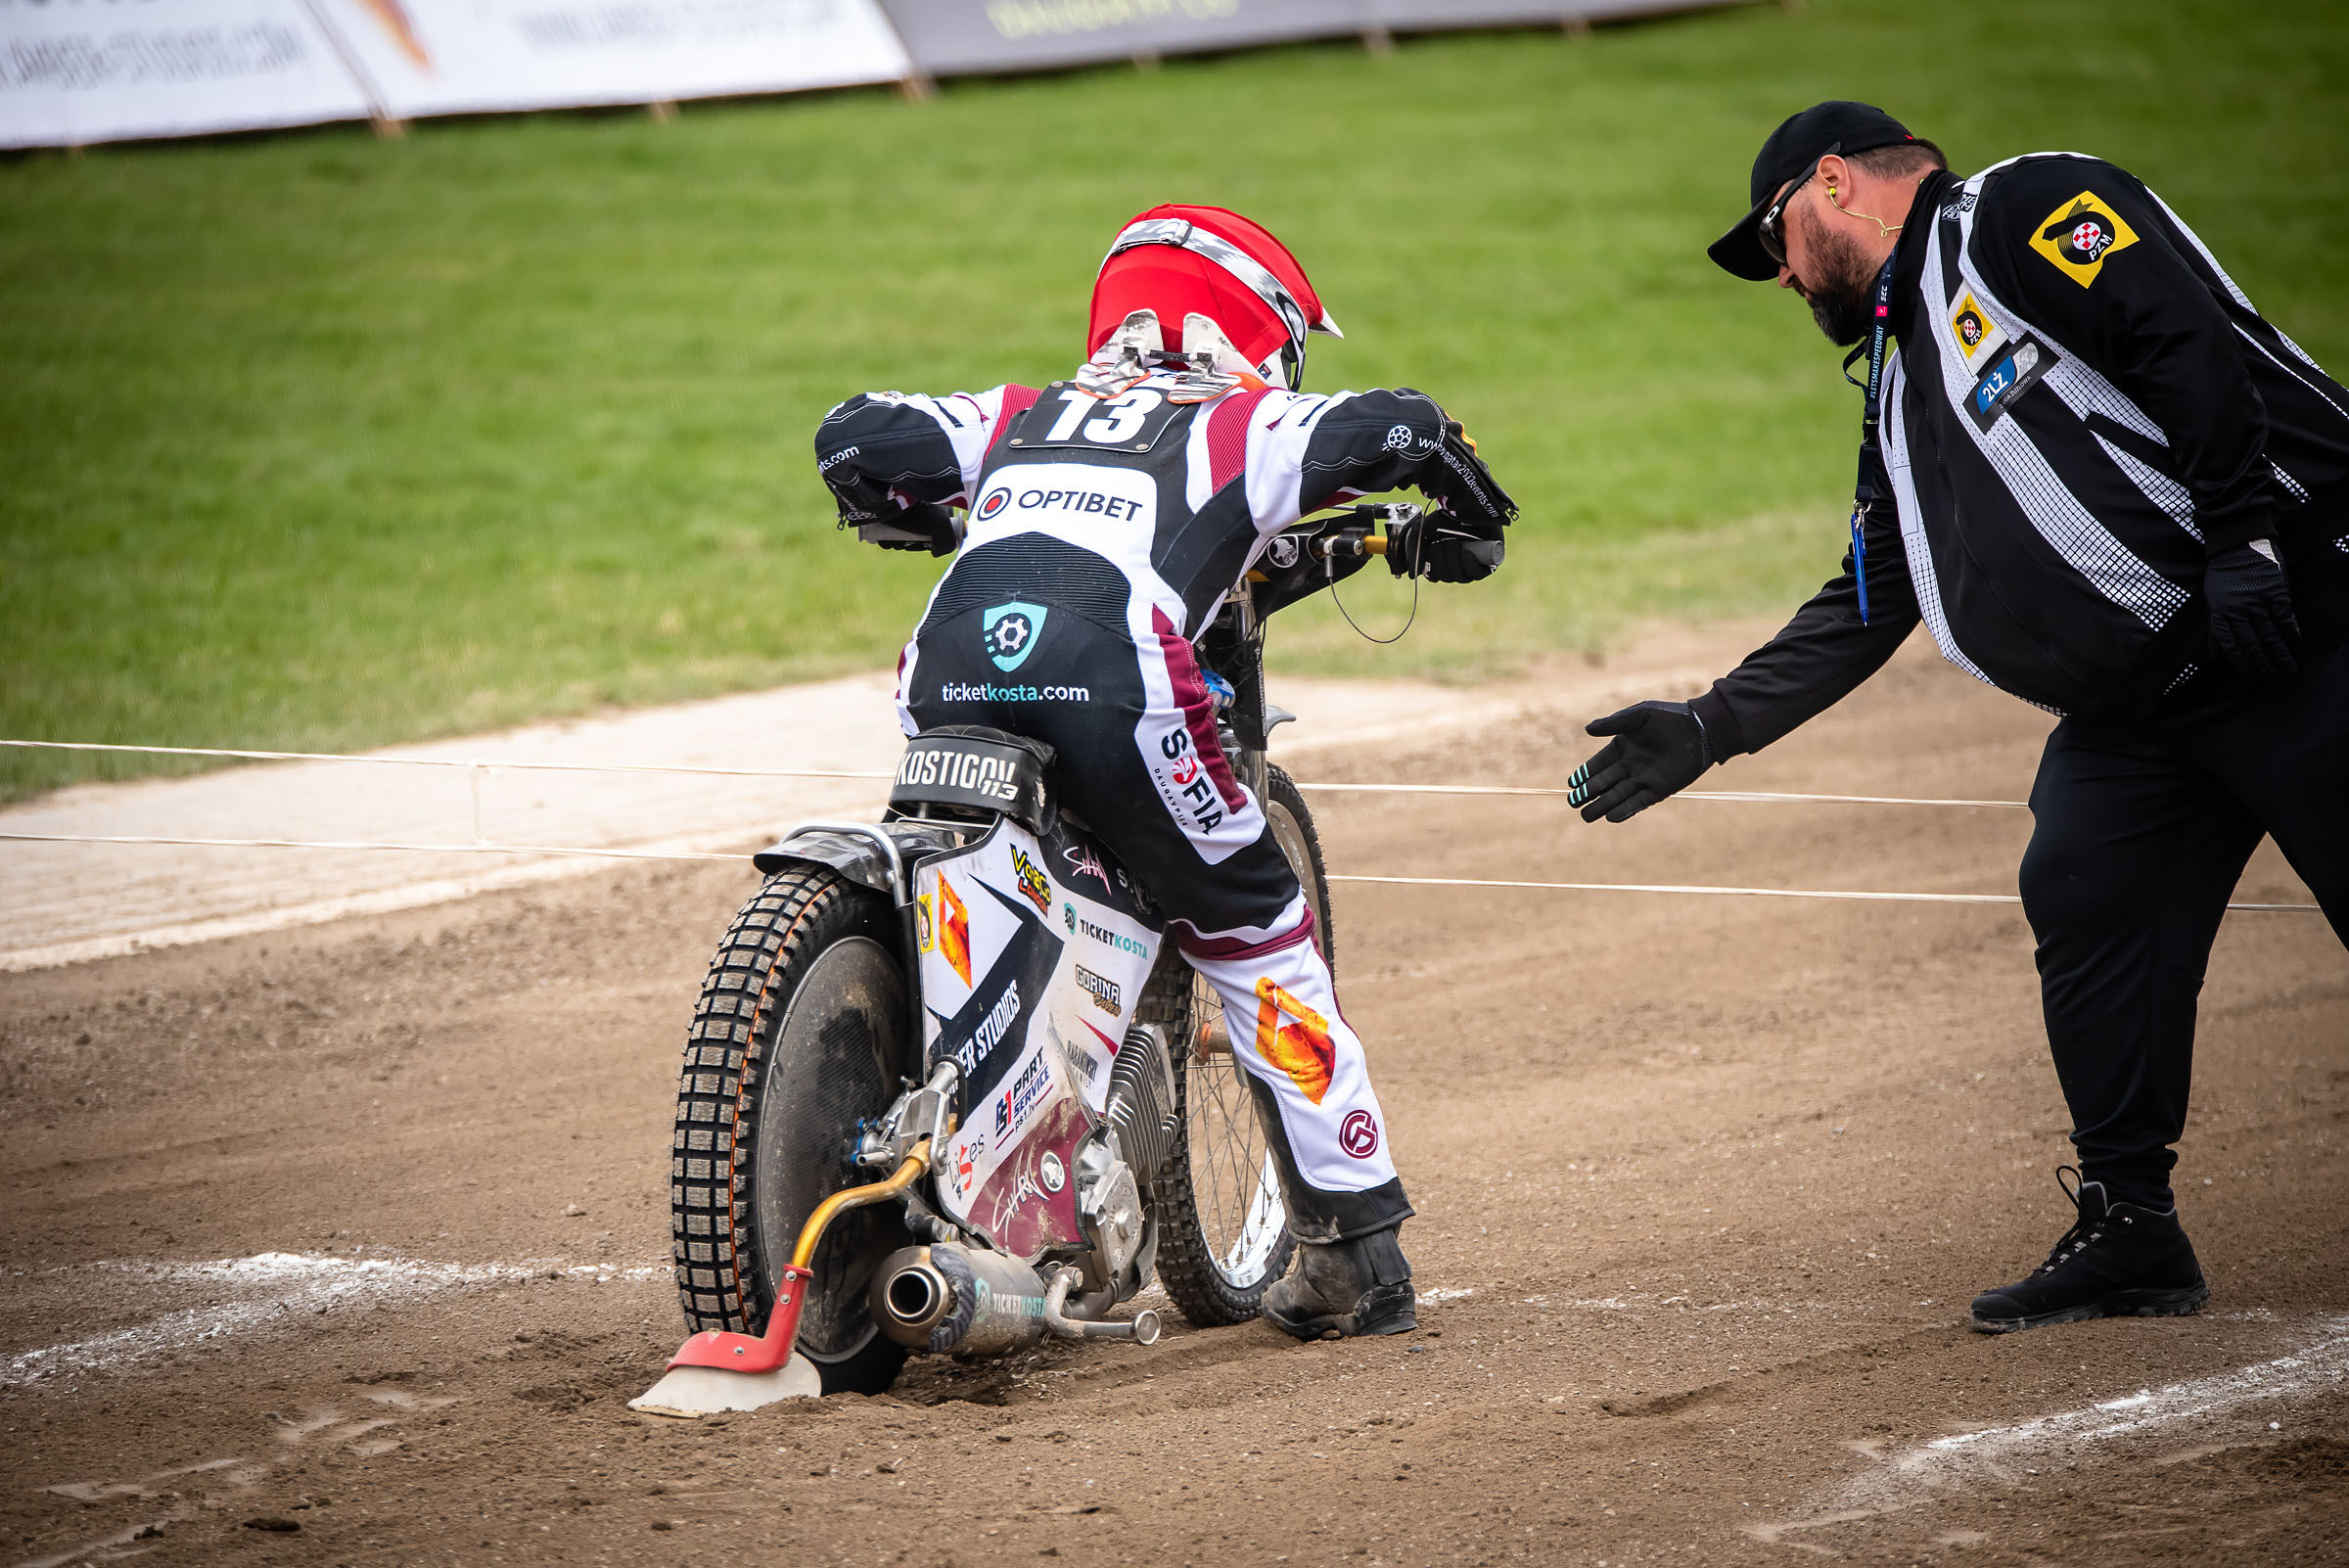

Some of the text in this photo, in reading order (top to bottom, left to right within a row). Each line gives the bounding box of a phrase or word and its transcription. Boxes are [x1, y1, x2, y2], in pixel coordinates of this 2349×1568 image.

[2089, 234, 2113, 261] PZM
[1969, 330, 1982, 346] PZM
[1869, 325, 1884, 399] #LETSMAKESPEEDWAY
[1045, 390, 1162, 443] 13
[1019, 490, 1143, 522] OPTIBET
[943, 682, 1089, 702] ticketkosta.com
[896, 750, 1016, 790] KOSTIGOV
[981, 779, 1018, 801] 113
[1080, 918, 1148, 960] TICKETKOSTA
[975, 979, 1021, 1062] STUDIOS
[1013, 1046, 1043, 1099] PART
[1014, 1066, 1050, 1118] SERVICE
